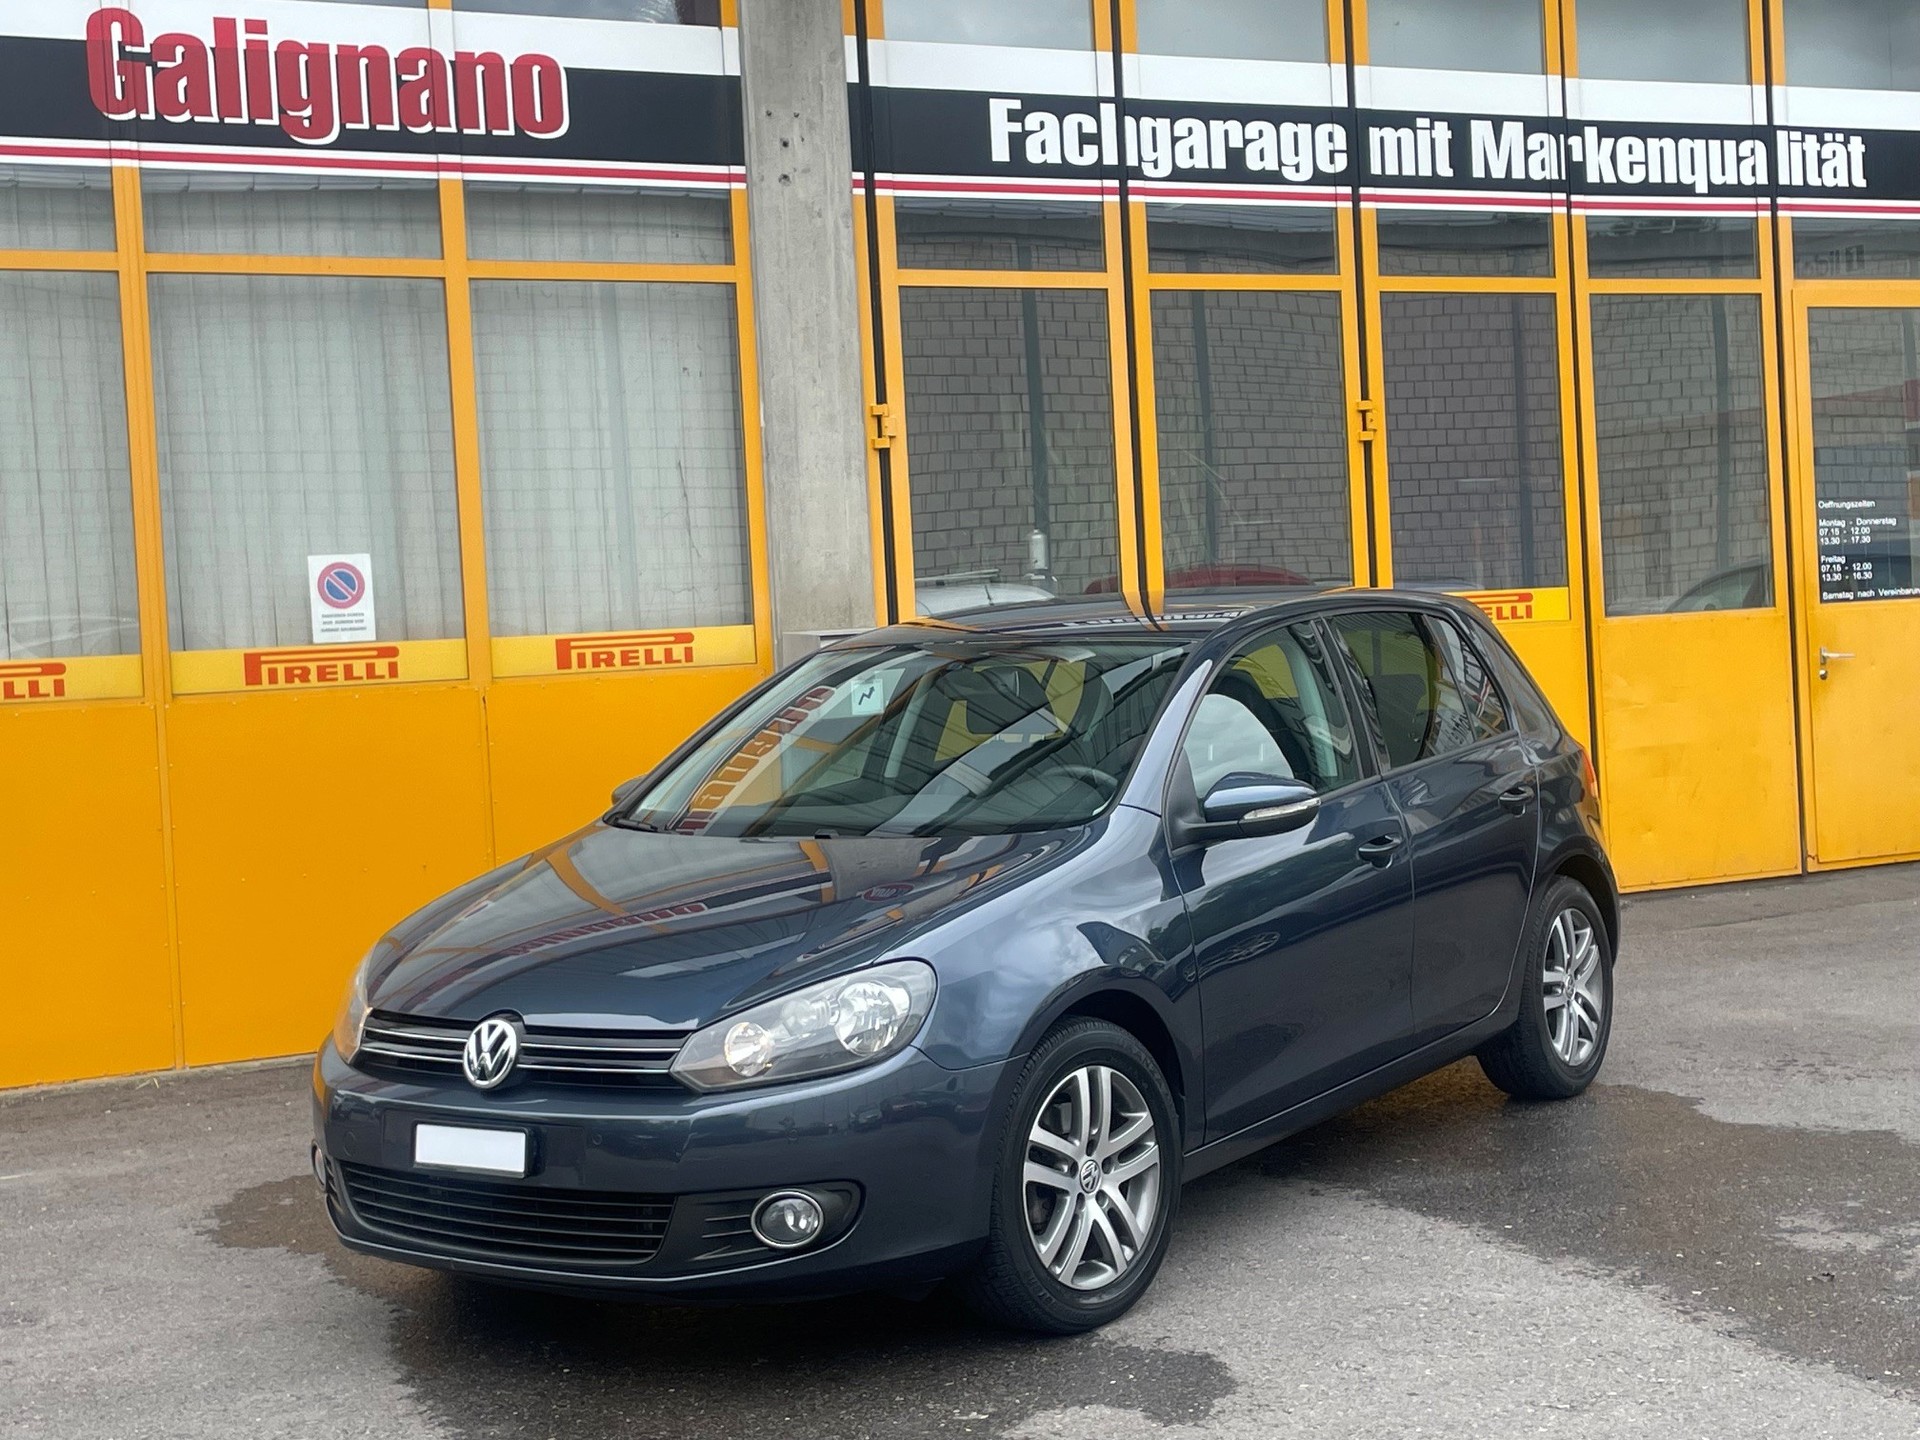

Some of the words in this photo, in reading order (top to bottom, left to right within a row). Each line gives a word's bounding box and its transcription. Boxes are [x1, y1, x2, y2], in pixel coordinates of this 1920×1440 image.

[86, 7, 569, 145] Galignano
[989, 97, 1347, 182] Fachgarage
[1369, 117, 1454, 177] mit
[1469, 119, 1867, 194] Markenqualität
[1819, 519, 1846, 528] Montag
[1856, 517, 1897, 526] Donnerstag
[1850, 527, 1871, 535] 12.00
[1820, 537, 1840, 545] 13.30
[1851, 535, 1871, 544] 17.30
[1821, 555, 1846, 564] Freitag
[1852, 562, 1872, 571] 12.00
[1822, 573, 1842, 582] 13.30
[1822, 591, 1854, 600] Samstag
[1857, 589, 1876, 598] nach
[555, 632, 694, 670] PIRELLI
[244, 646, 399, 686] PIRELLI
